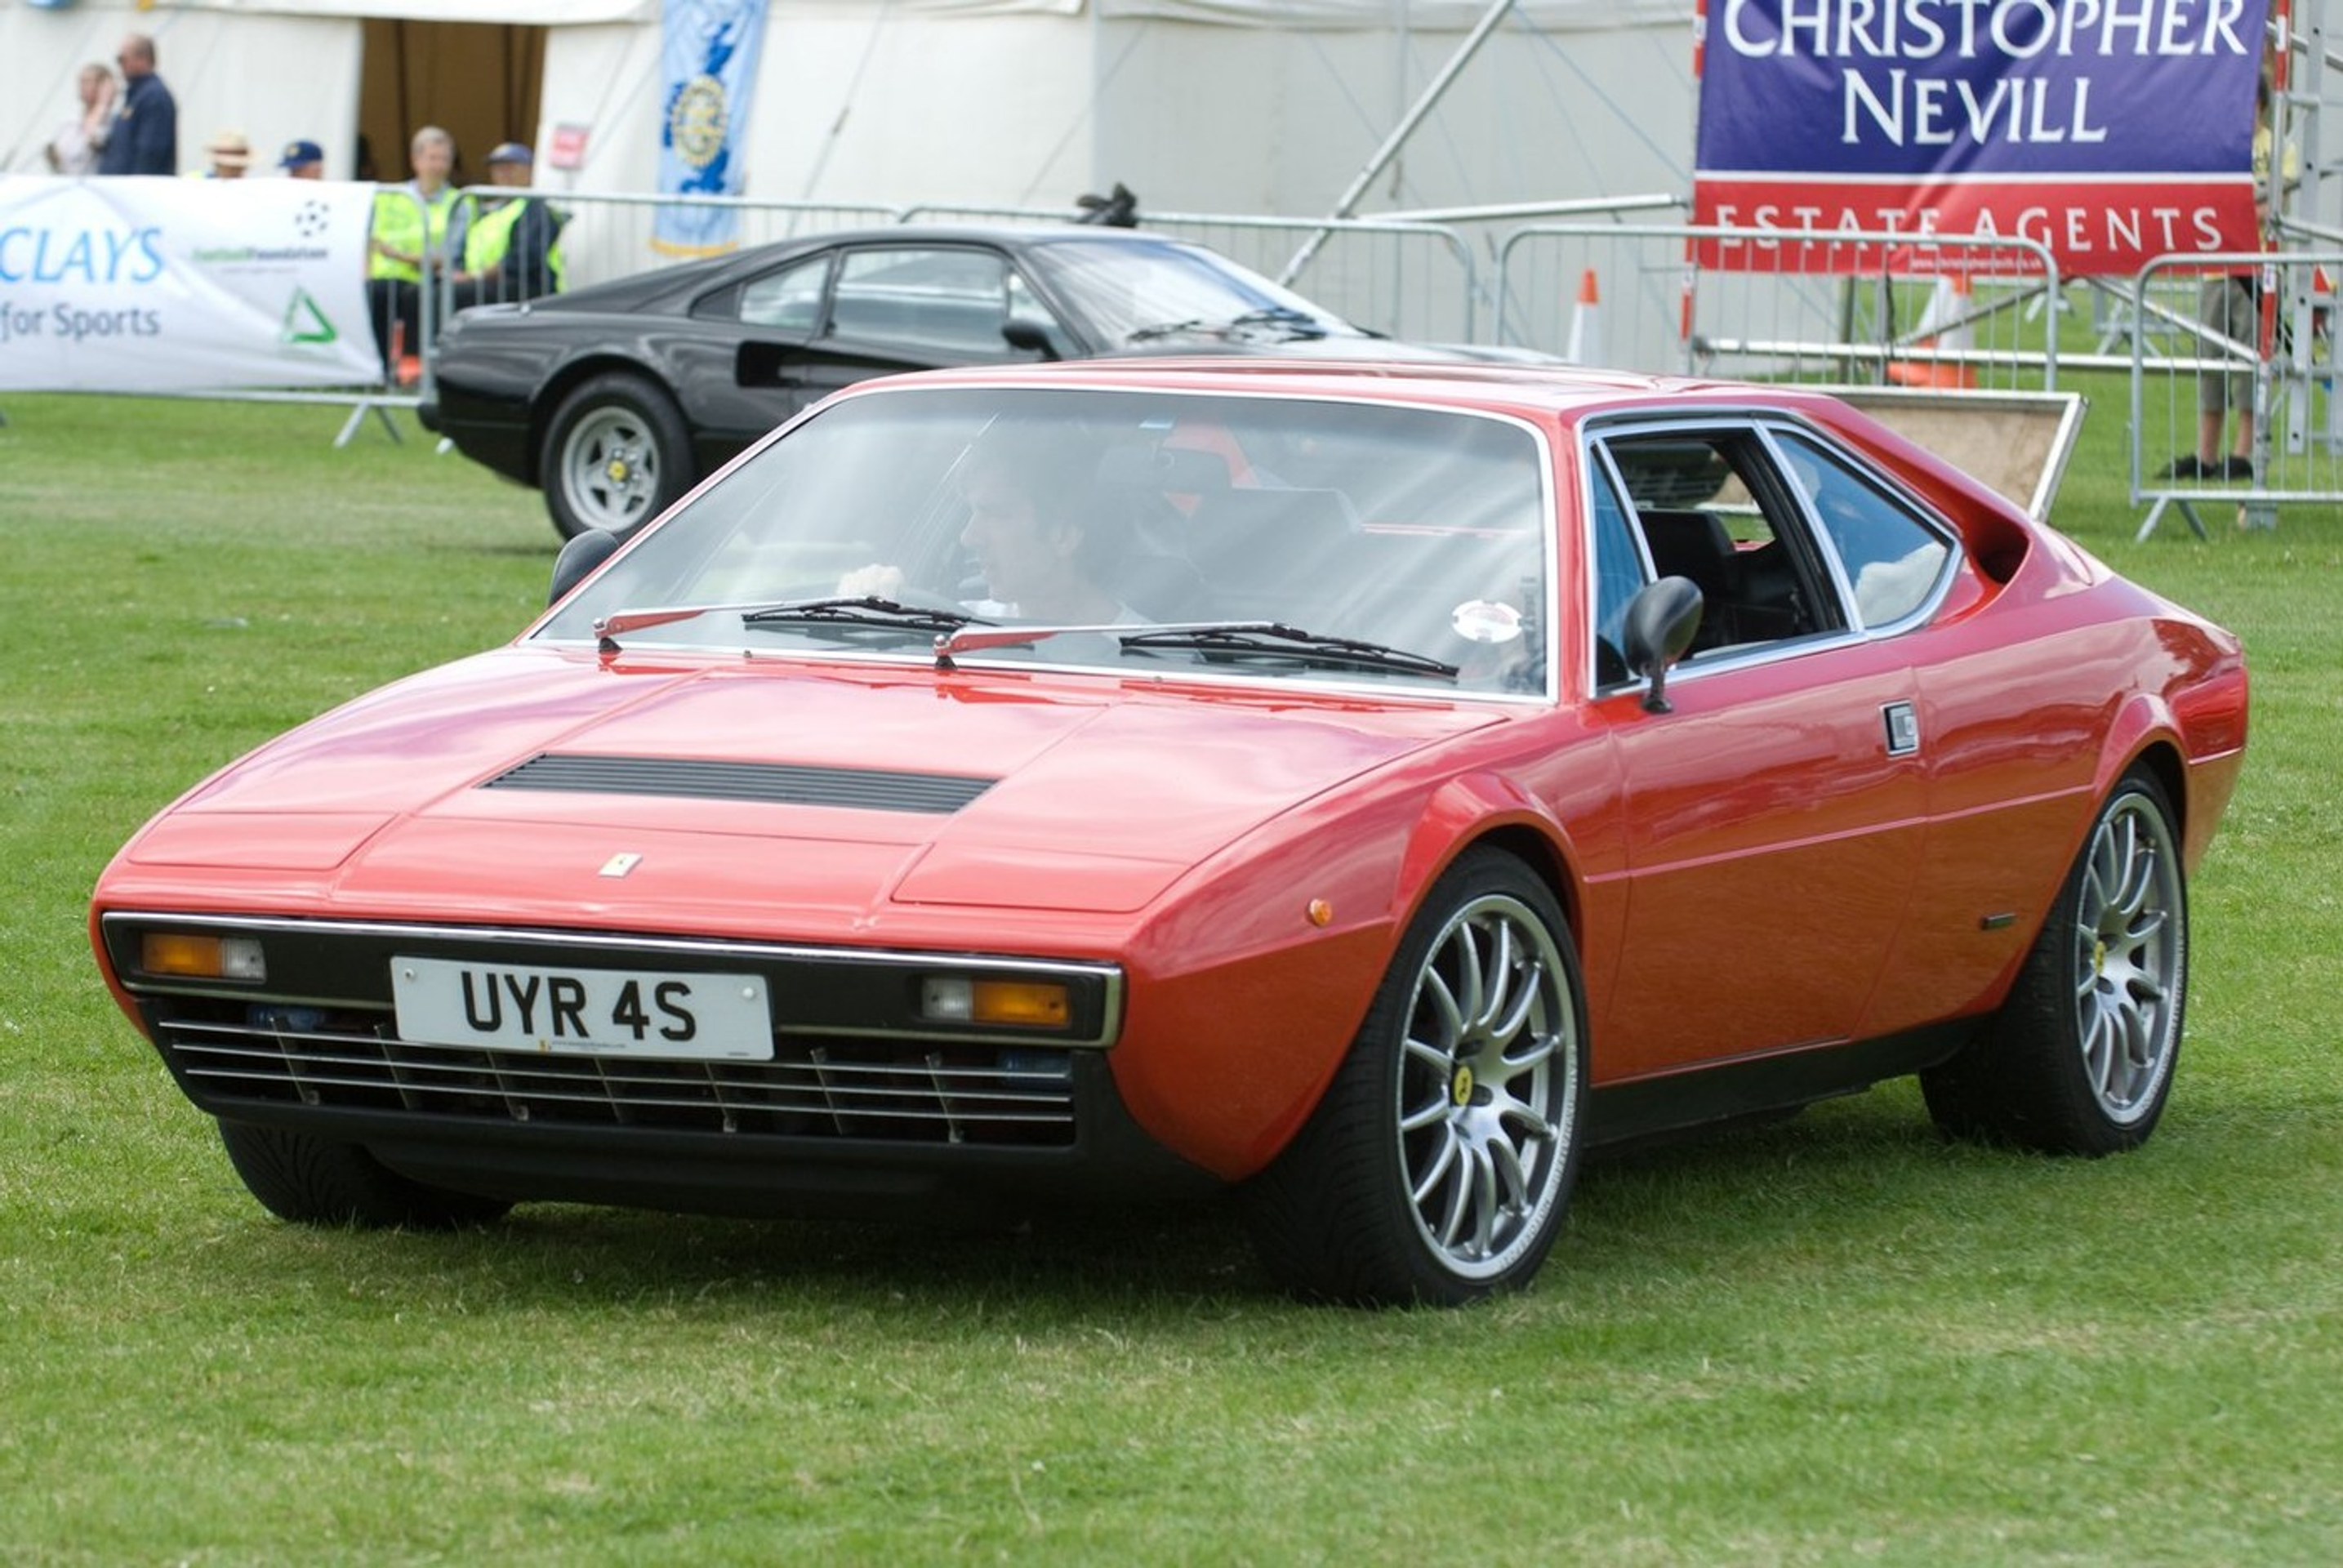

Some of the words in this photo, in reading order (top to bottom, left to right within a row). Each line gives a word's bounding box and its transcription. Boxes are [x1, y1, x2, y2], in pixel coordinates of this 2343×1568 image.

[1724, 0, 2248, 58] CHRISTOPHER
[1842, 68, 2108, 146] NEVILL
[0, 228, 164, 283] CLAYS
[1716, 204, 1940, 250] ESTATE
[1967, 207, 2222, 252] AGENTS
[0, 301, 44, 342] for
[52, 302, 161, 343] Sports
[461, 971, 590, 1038] UYR
[611, 980, 697, 1042] 4S
